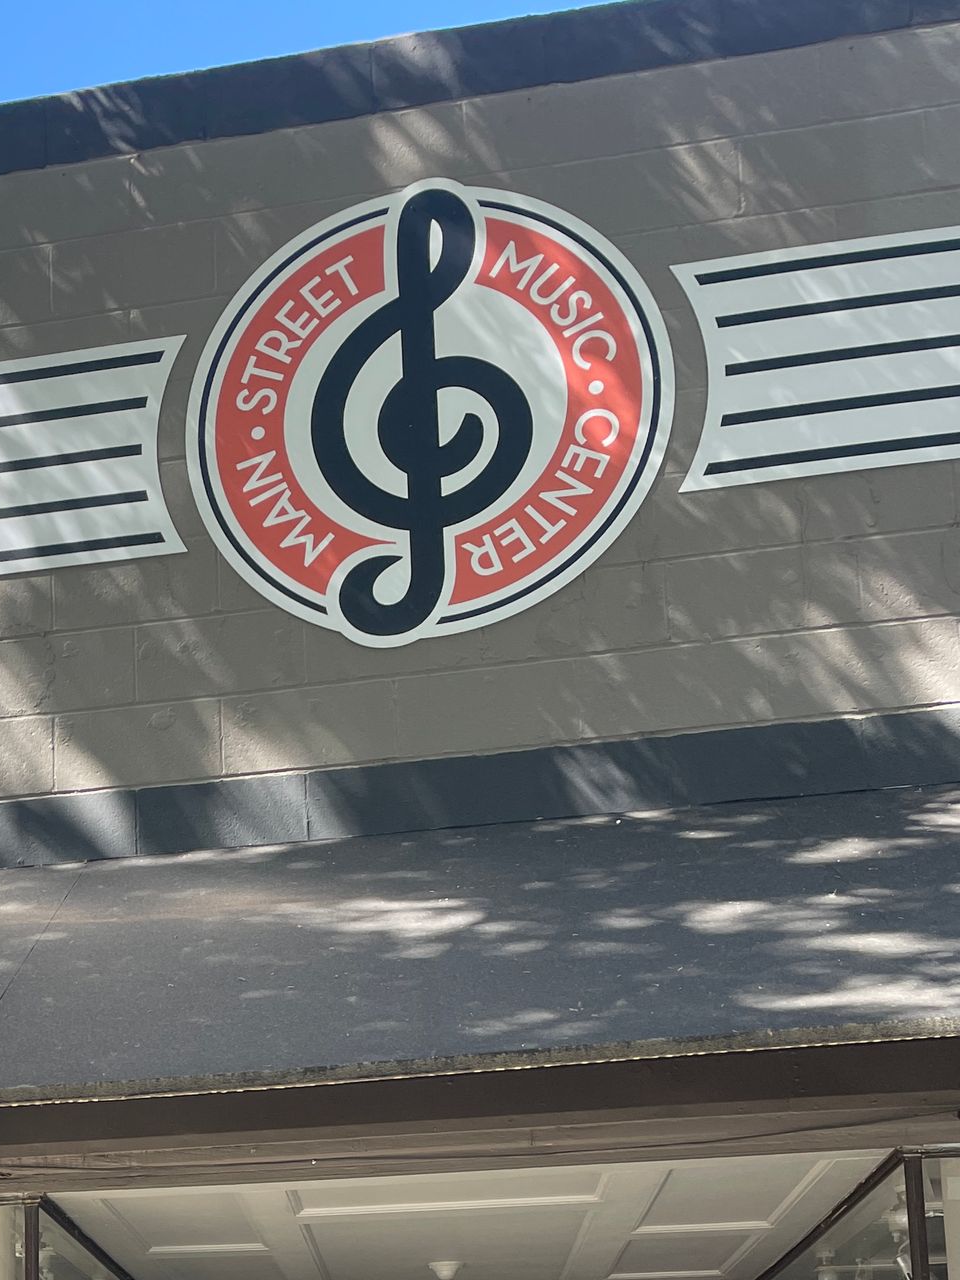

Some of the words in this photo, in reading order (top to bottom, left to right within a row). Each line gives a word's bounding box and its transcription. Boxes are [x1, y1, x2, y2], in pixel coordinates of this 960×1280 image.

[236, 255, 360, 416] STREET
[489, 240, 618, 371] MUSIC
[236, 450, 335, 567] MAIN
[461, 408, 621, 577] CENTER
